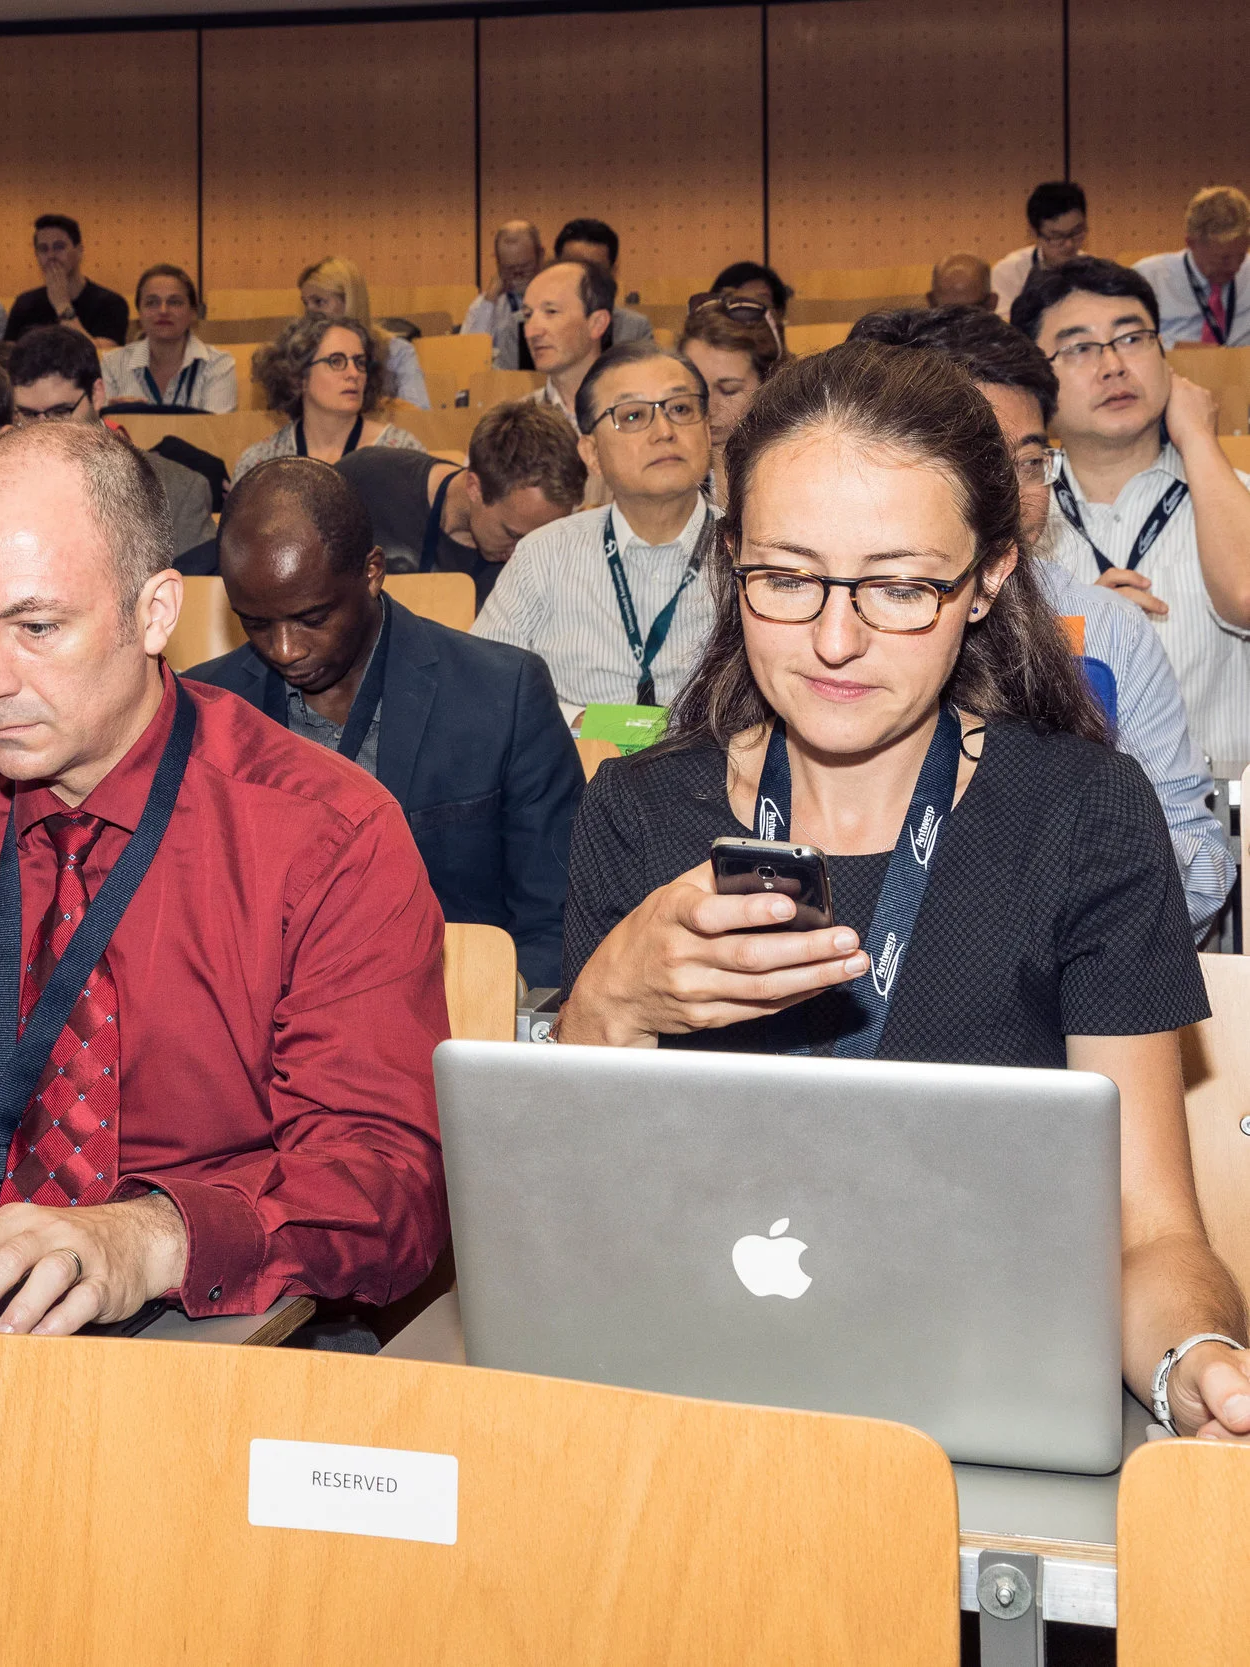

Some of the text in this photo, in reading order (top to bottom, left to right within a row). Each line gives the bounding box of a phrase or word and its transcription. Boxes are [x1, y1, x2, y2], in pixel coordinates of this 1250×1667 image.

[768, 811, 776, 841] Antwe
[915, 805, 935, 847] Antwerp
[876, 932, 896, 977] Antwerp
[312, 1470, 398, 1493] RESERVED
